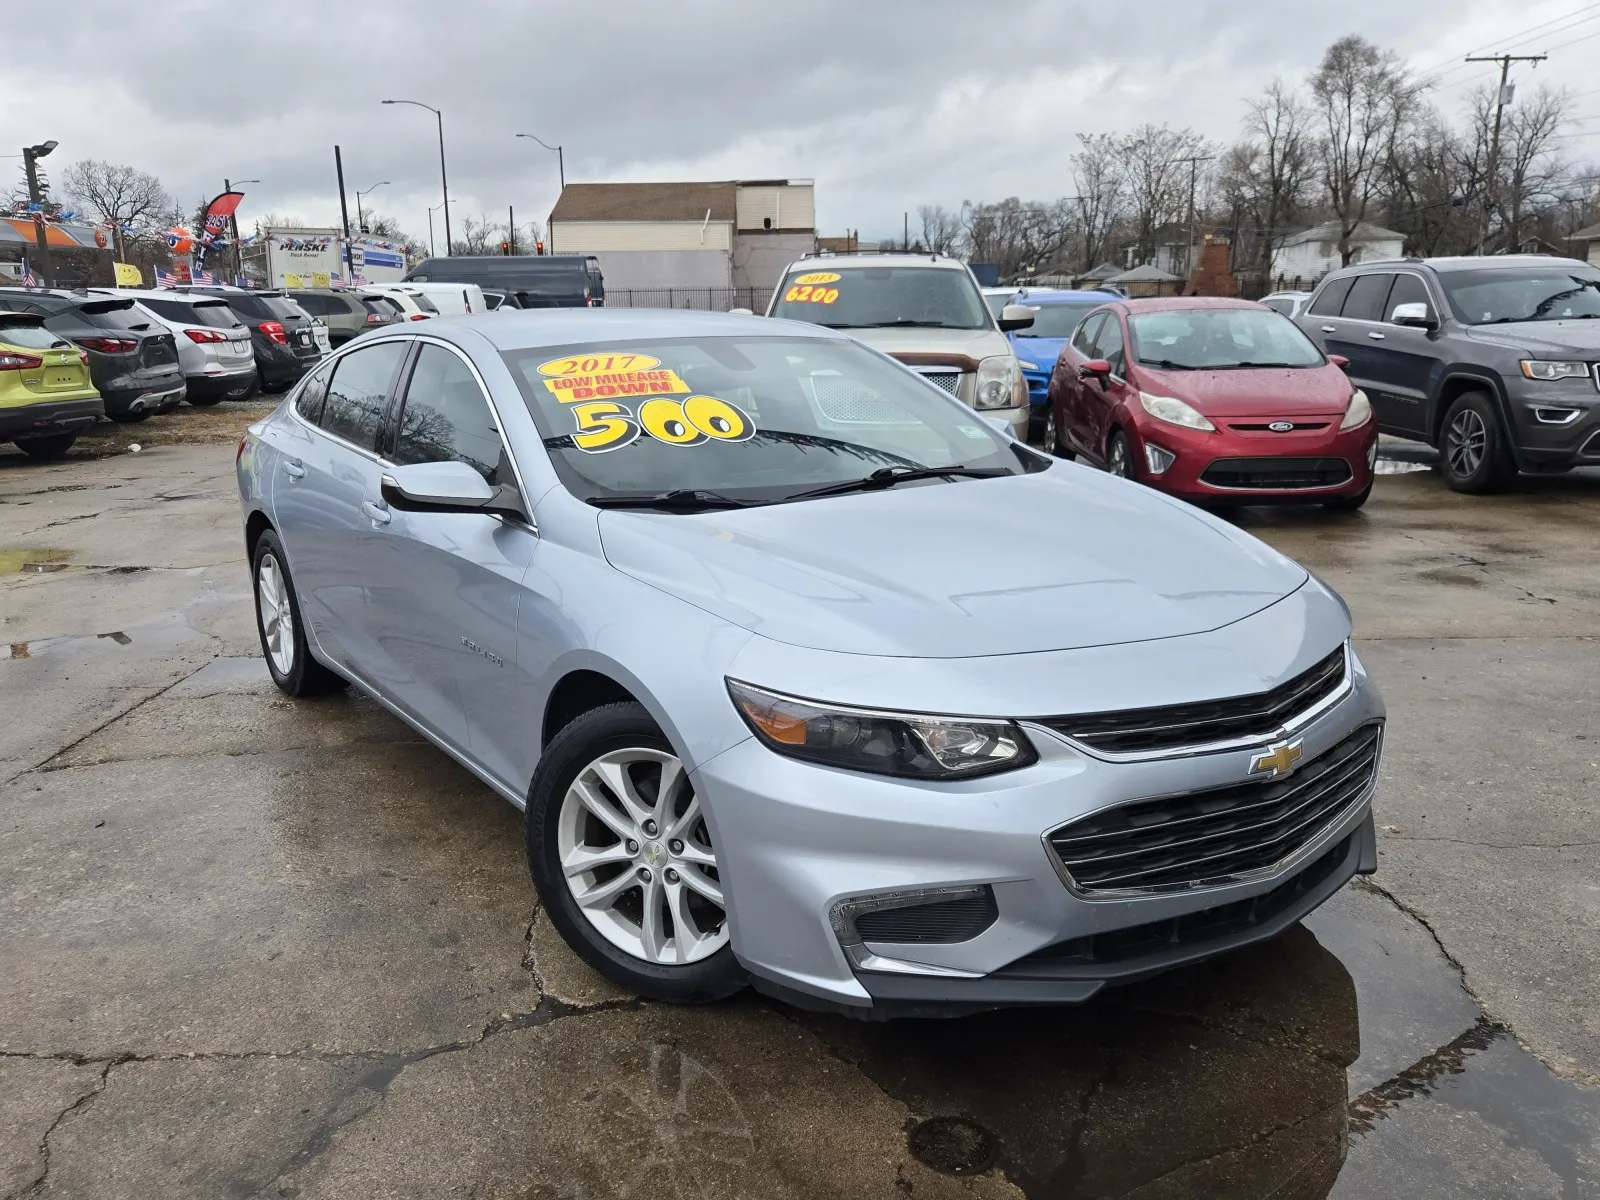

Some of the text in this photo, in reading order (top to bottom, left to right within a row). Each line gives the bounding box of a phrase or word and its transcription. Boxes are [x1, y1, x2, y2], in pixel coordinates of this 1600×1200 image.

[280, 243, 329, 252] PENSKE
[785, 286, 839, 304] 6200
[560, 355, 636, 375] 2017
[553, 370, 670, 390] LOW MILEAGE
[572, 382, 674, 400] DOWN
[570, 395, 757, 455] 500
